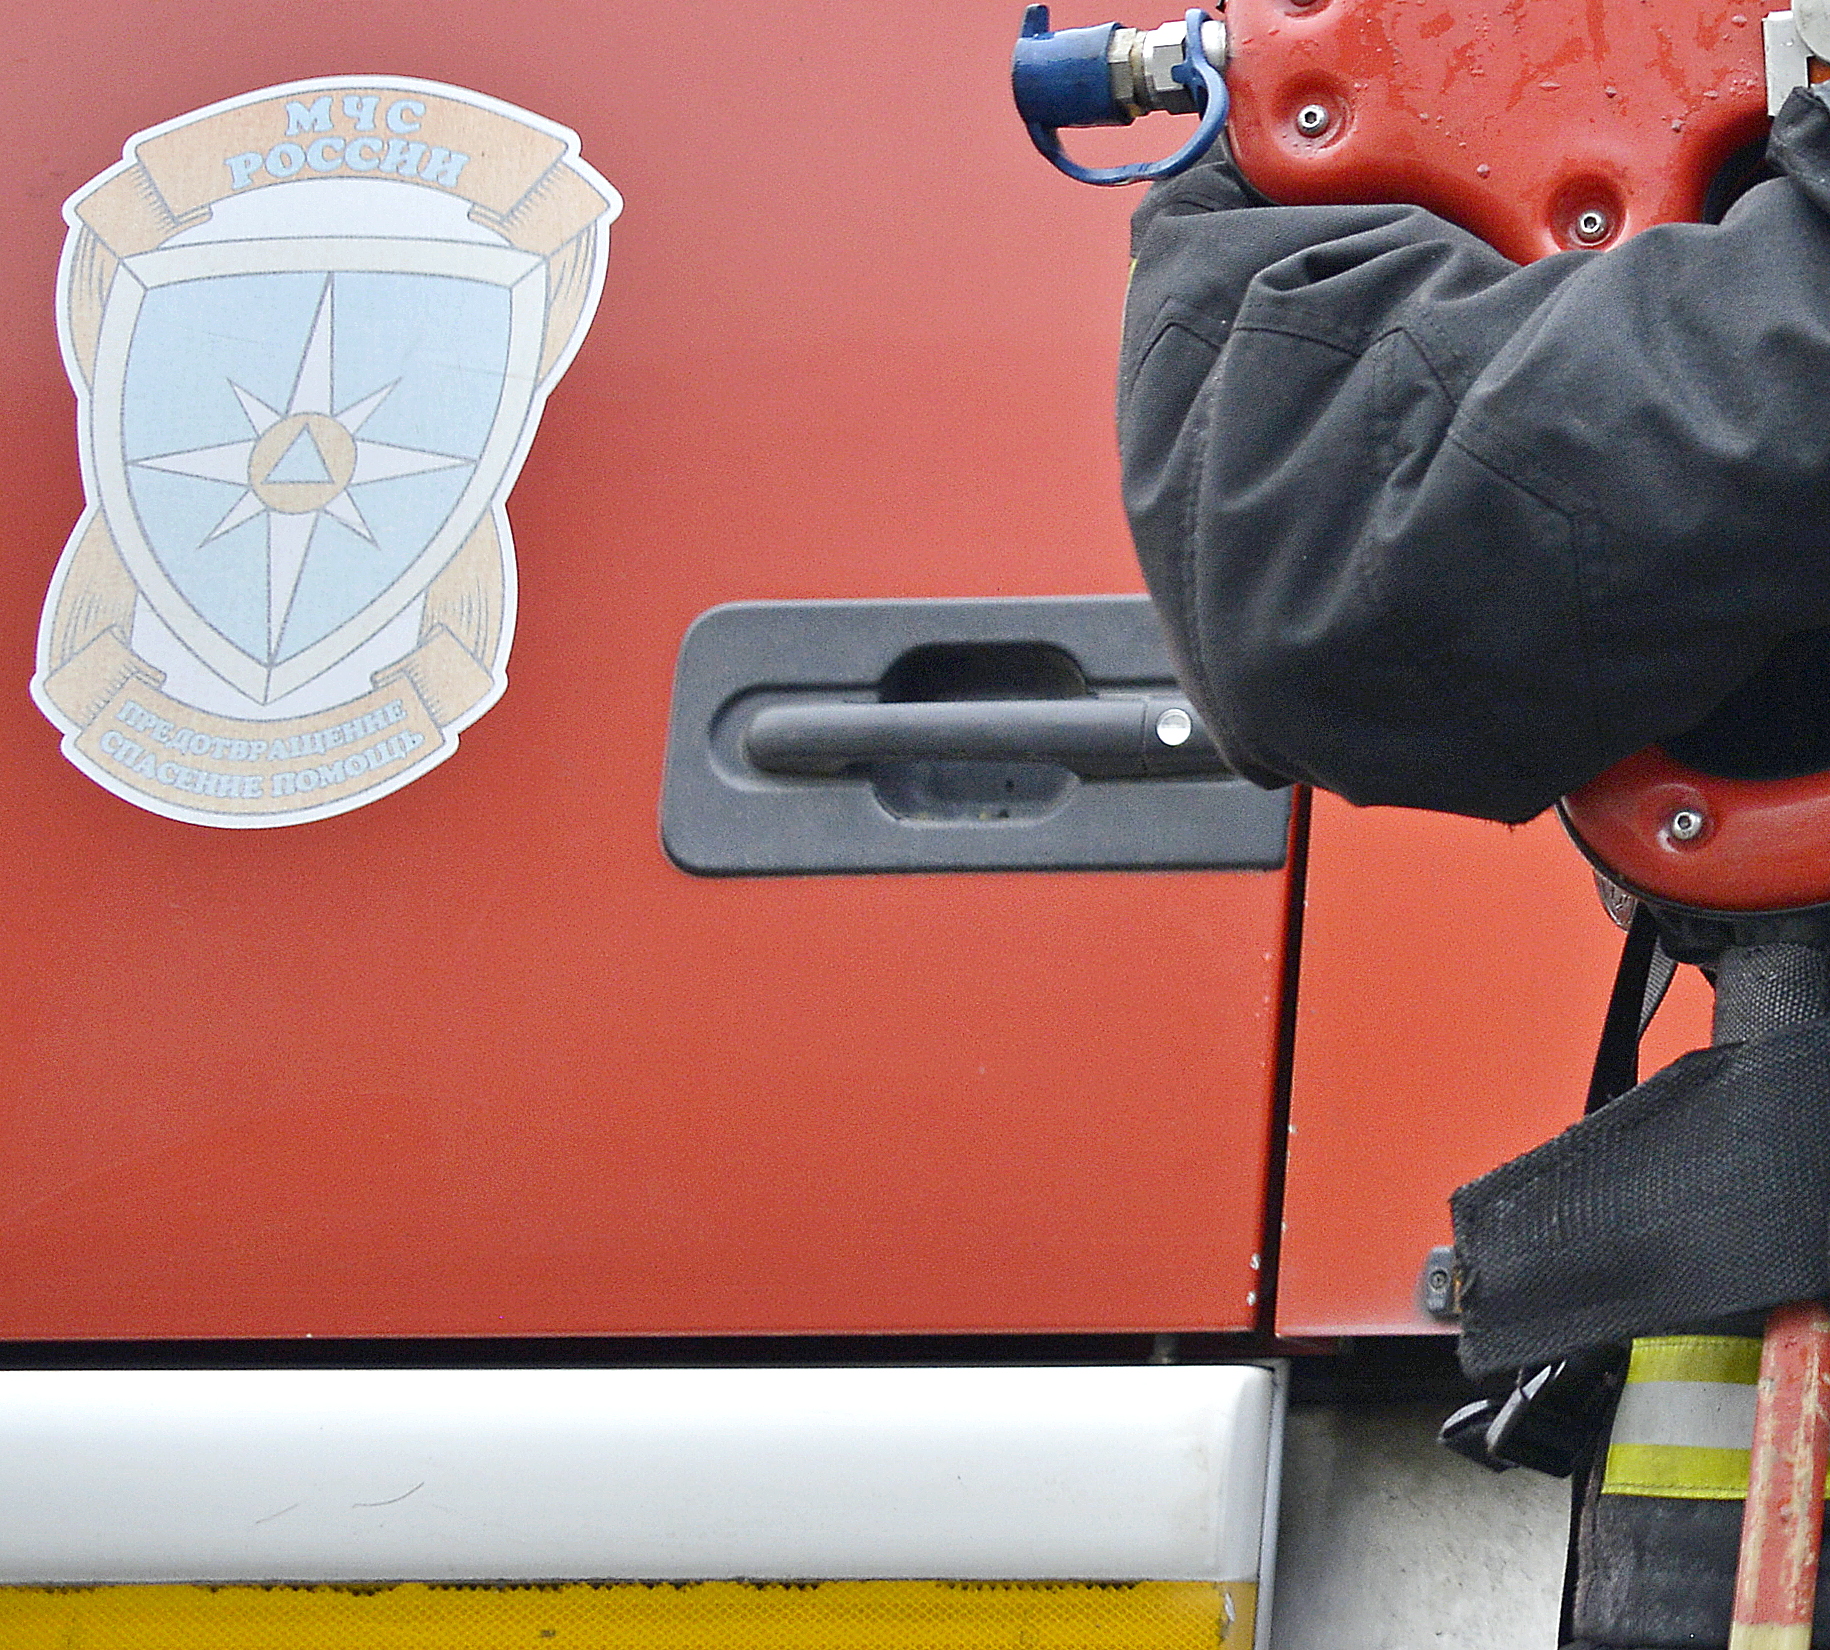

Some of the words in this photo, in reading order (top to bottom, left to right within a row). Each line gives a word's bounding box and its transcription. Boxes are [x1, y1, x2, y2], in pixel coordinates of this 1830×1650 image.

[285, 95, 426, 137] МЧС
[224, 137, 471, 193] РОССИИ
[116, 699, 409, 763] ПРЕДОТВРАЩЕНИЕ
[99, 729, 264, 800] СПАСЕНИЕ
[271, 729, 426, 798] ПОМОЩЬ
